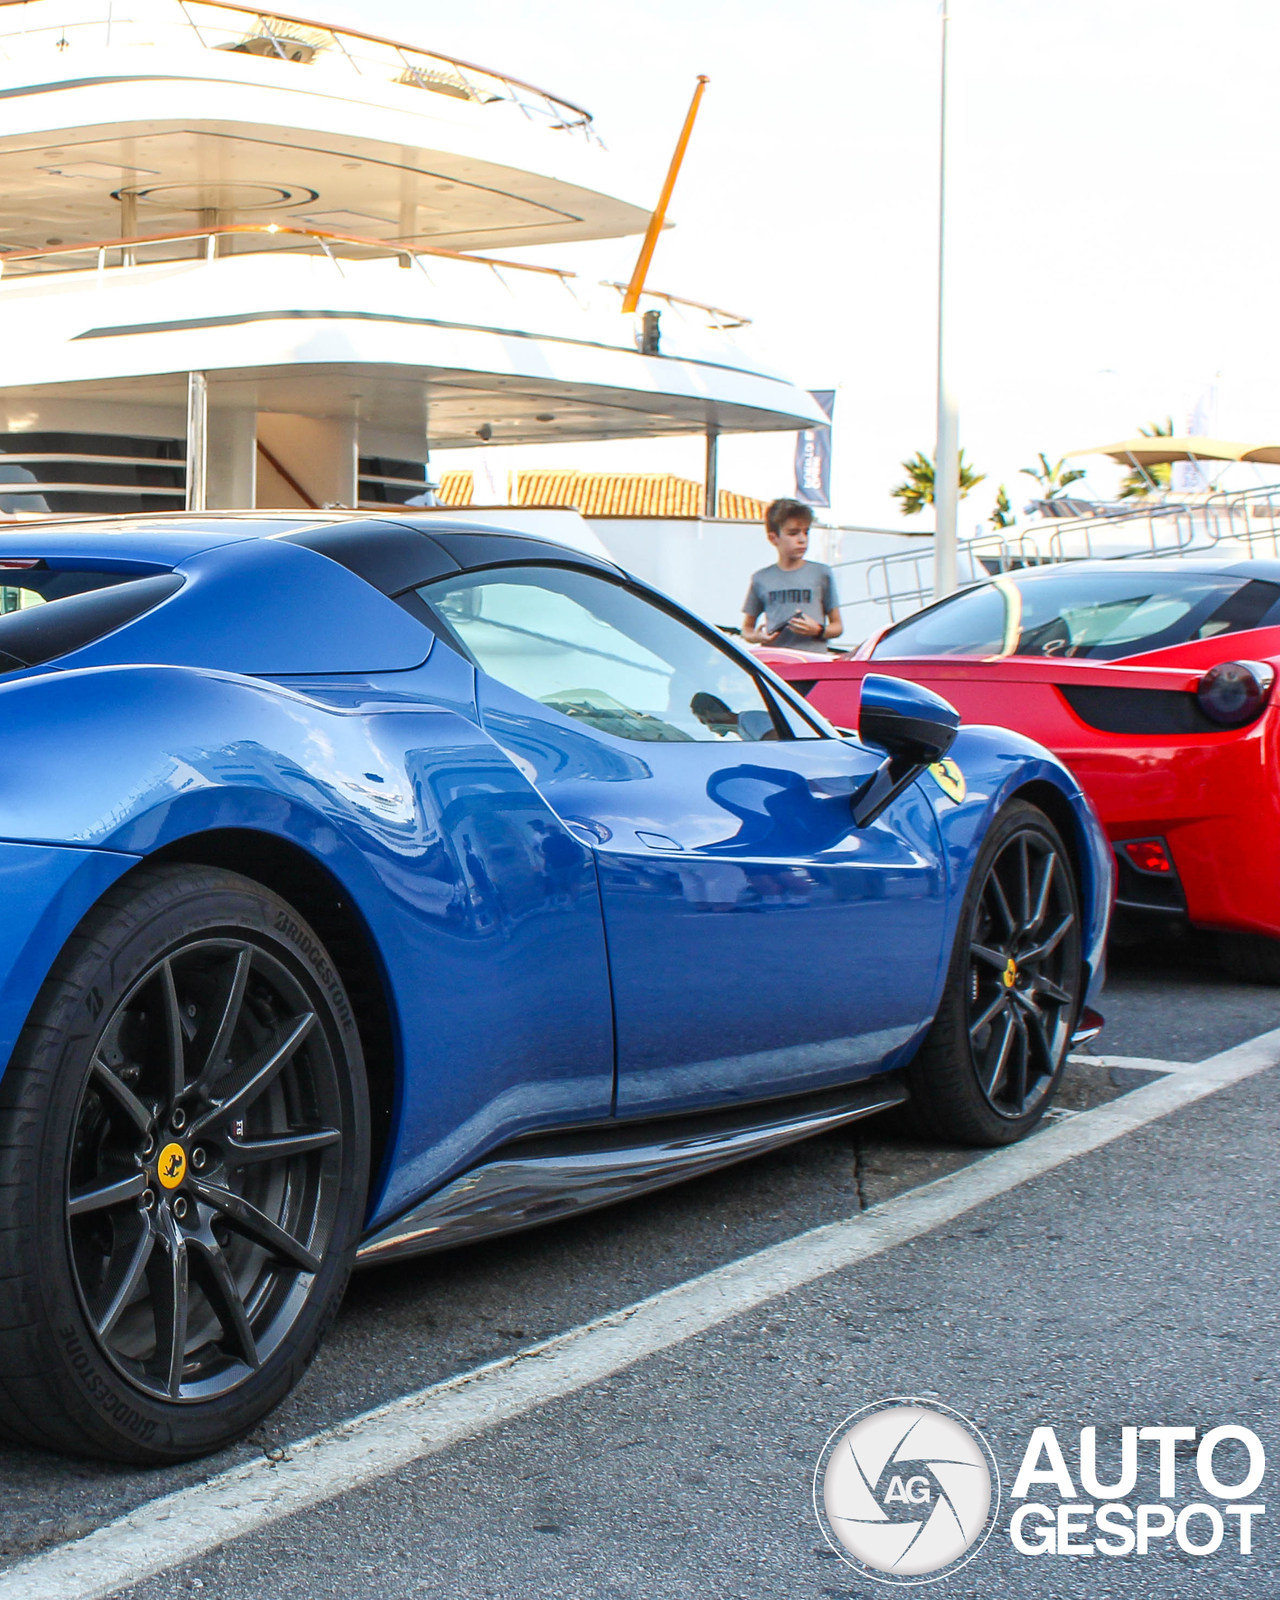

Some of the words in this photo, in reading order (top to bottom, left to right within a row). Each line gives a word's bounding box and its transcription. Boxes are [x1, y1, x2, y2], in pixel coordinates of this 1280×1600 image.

[768, 589, 812, 604] PUMA
[273, 910, 355, 1034] BRIDGESTONE
[59, 1323, 159, 1442] BRIDGESTONE
